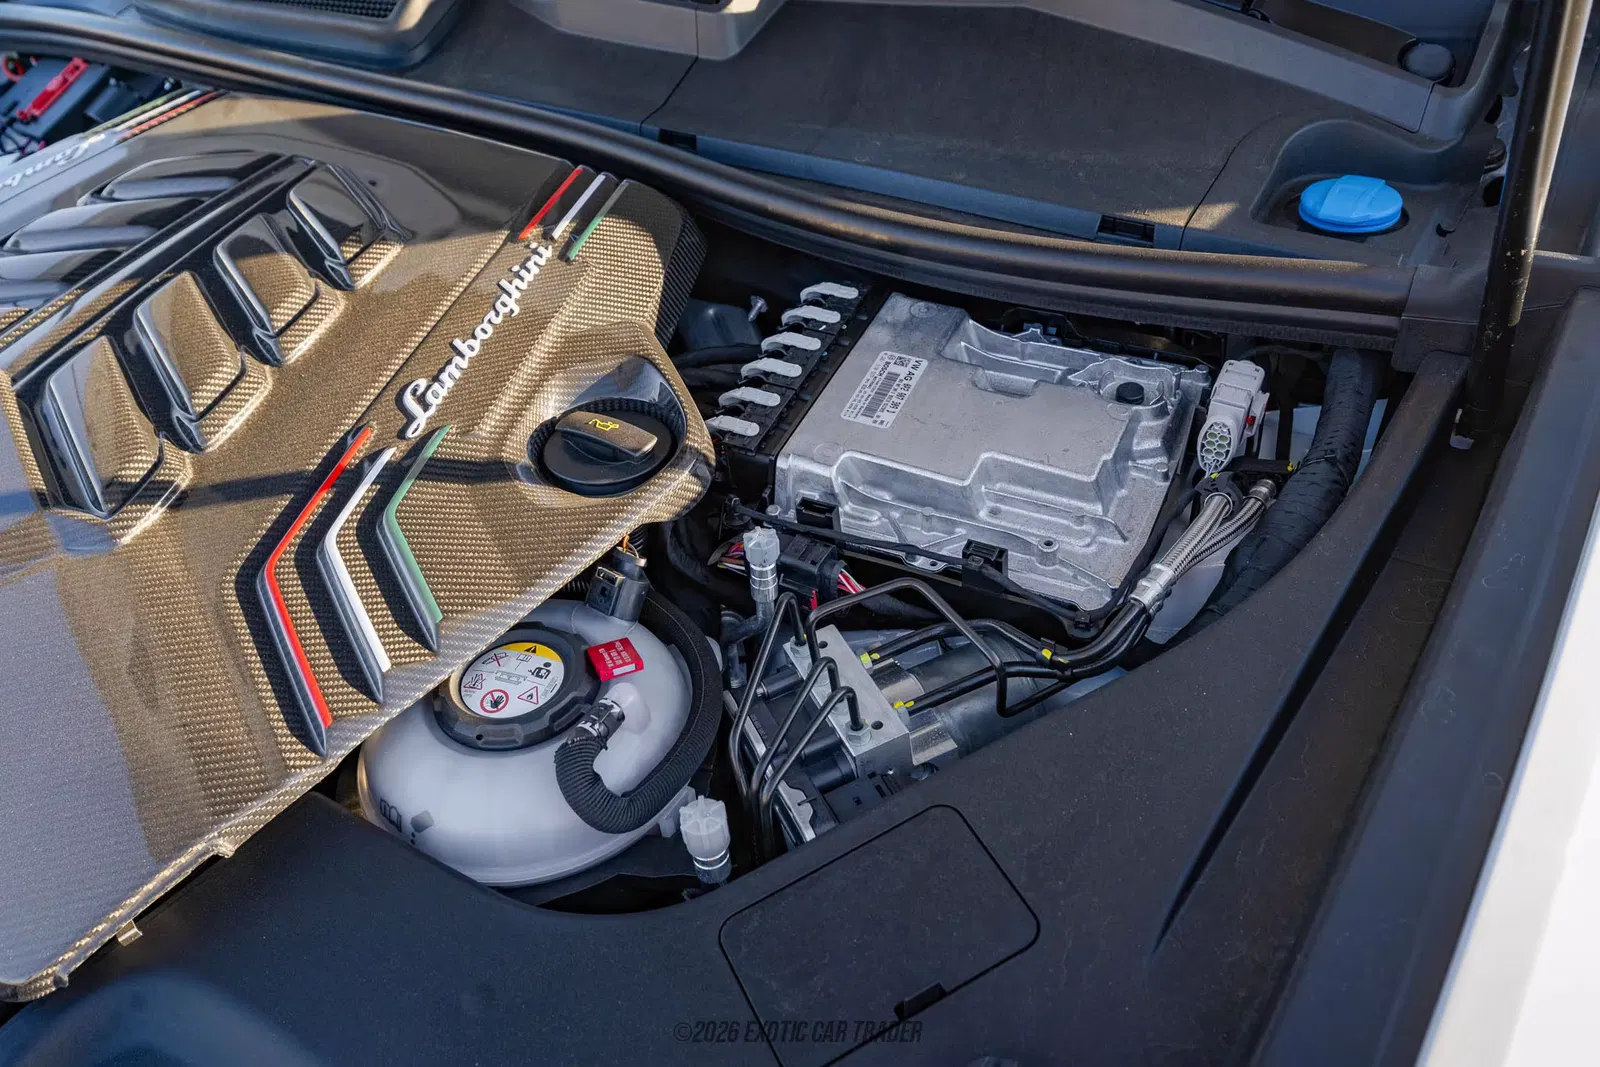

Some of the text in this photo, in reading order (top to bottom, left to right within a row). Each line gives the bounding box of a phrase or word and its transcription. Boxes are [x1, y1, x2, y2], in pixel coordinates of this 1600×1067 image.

[403, 242, 552, 438] Lamborghini
[878, 361, 891, 377] BOSCH
[910, 360, 924, 371] VW
[904, 371, 915, 381] AG
